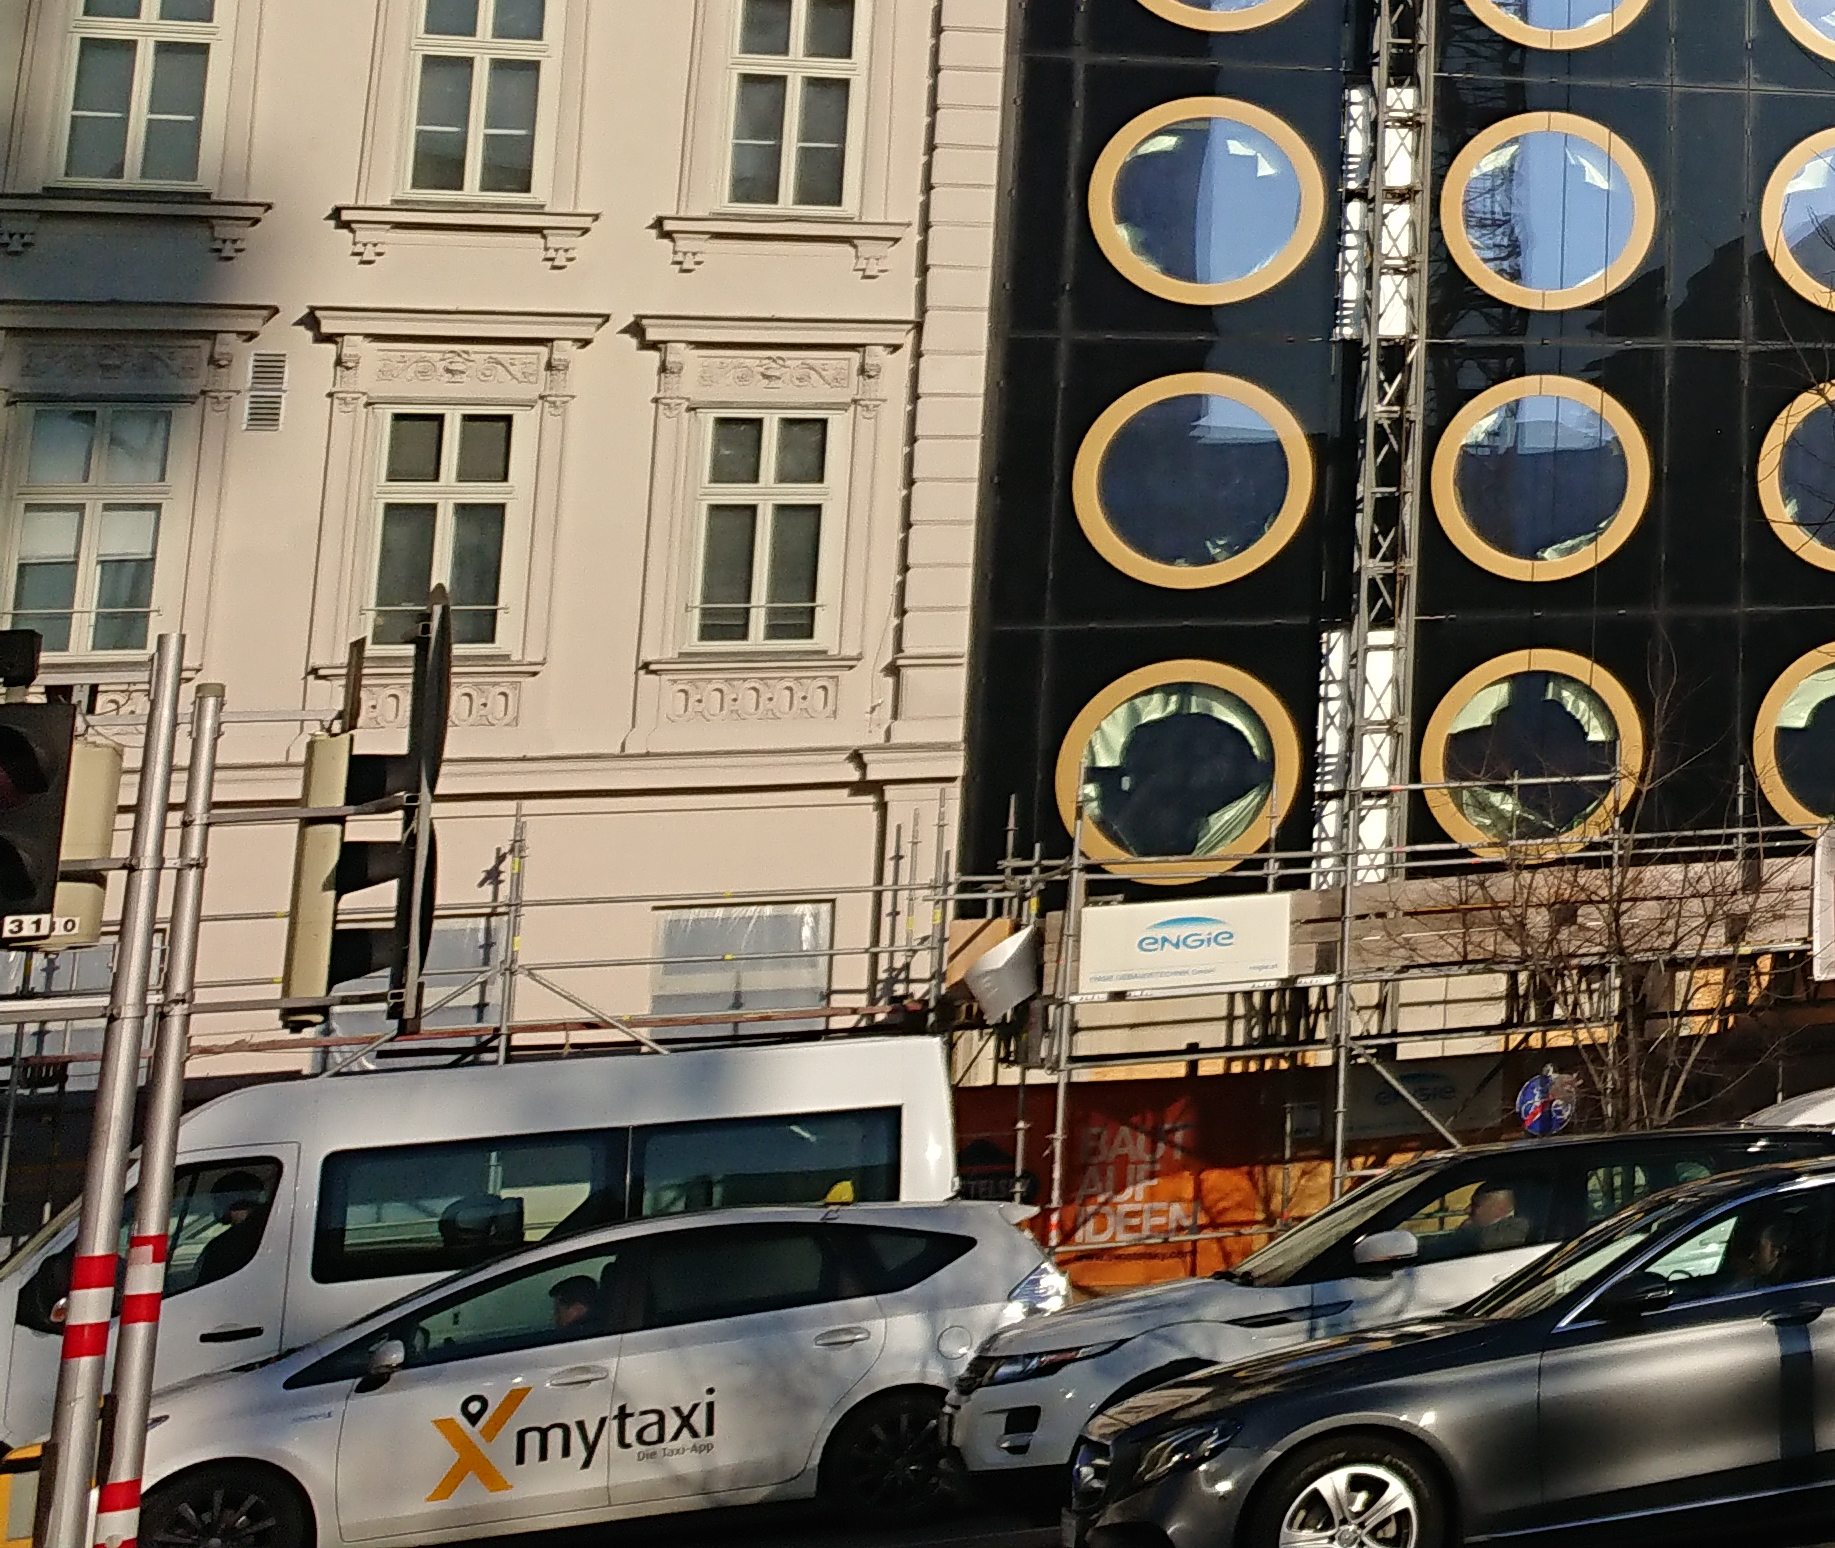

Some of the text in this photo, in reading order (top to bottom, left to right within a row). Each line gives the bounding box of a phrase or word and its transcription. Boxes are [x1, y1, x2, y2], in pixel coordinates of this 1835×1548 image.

[8, 917, 42, 935] 31
[1074, 1201, 1201, 1244] IDEEN
[515, 1385, 716, 1470] mytaxi
[636, 1441, 715, 1463] Die Taxi-App
